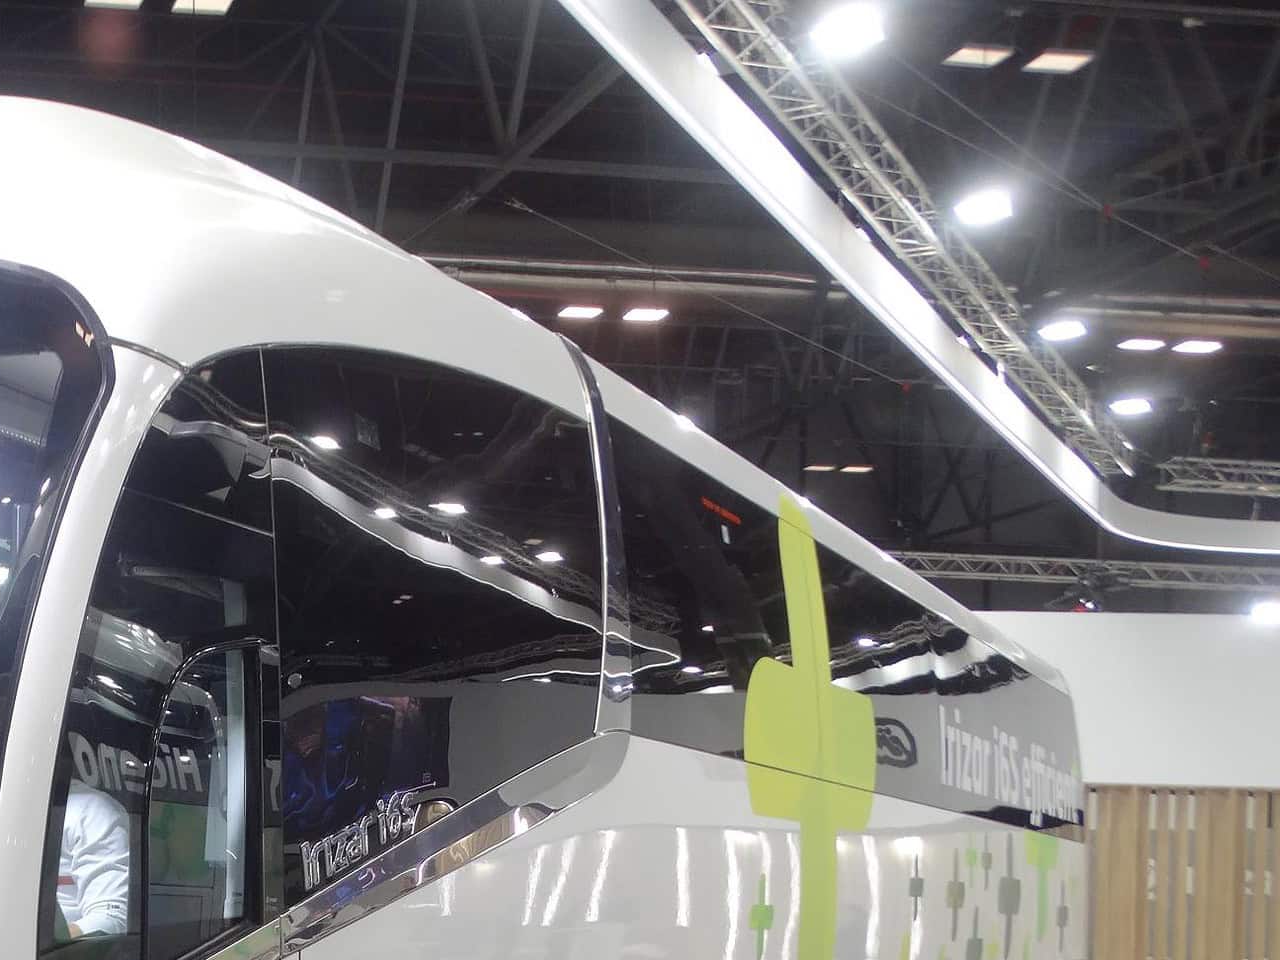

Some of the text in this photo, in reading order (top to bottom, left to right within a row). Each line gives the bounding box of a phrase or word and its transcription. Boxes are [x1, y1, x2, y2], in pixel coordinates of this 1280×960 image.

[938, 704, 992, 796] Irizar
[993, 725, 1021, 805] i6S
[300, 815, 373, 892] Irizar
